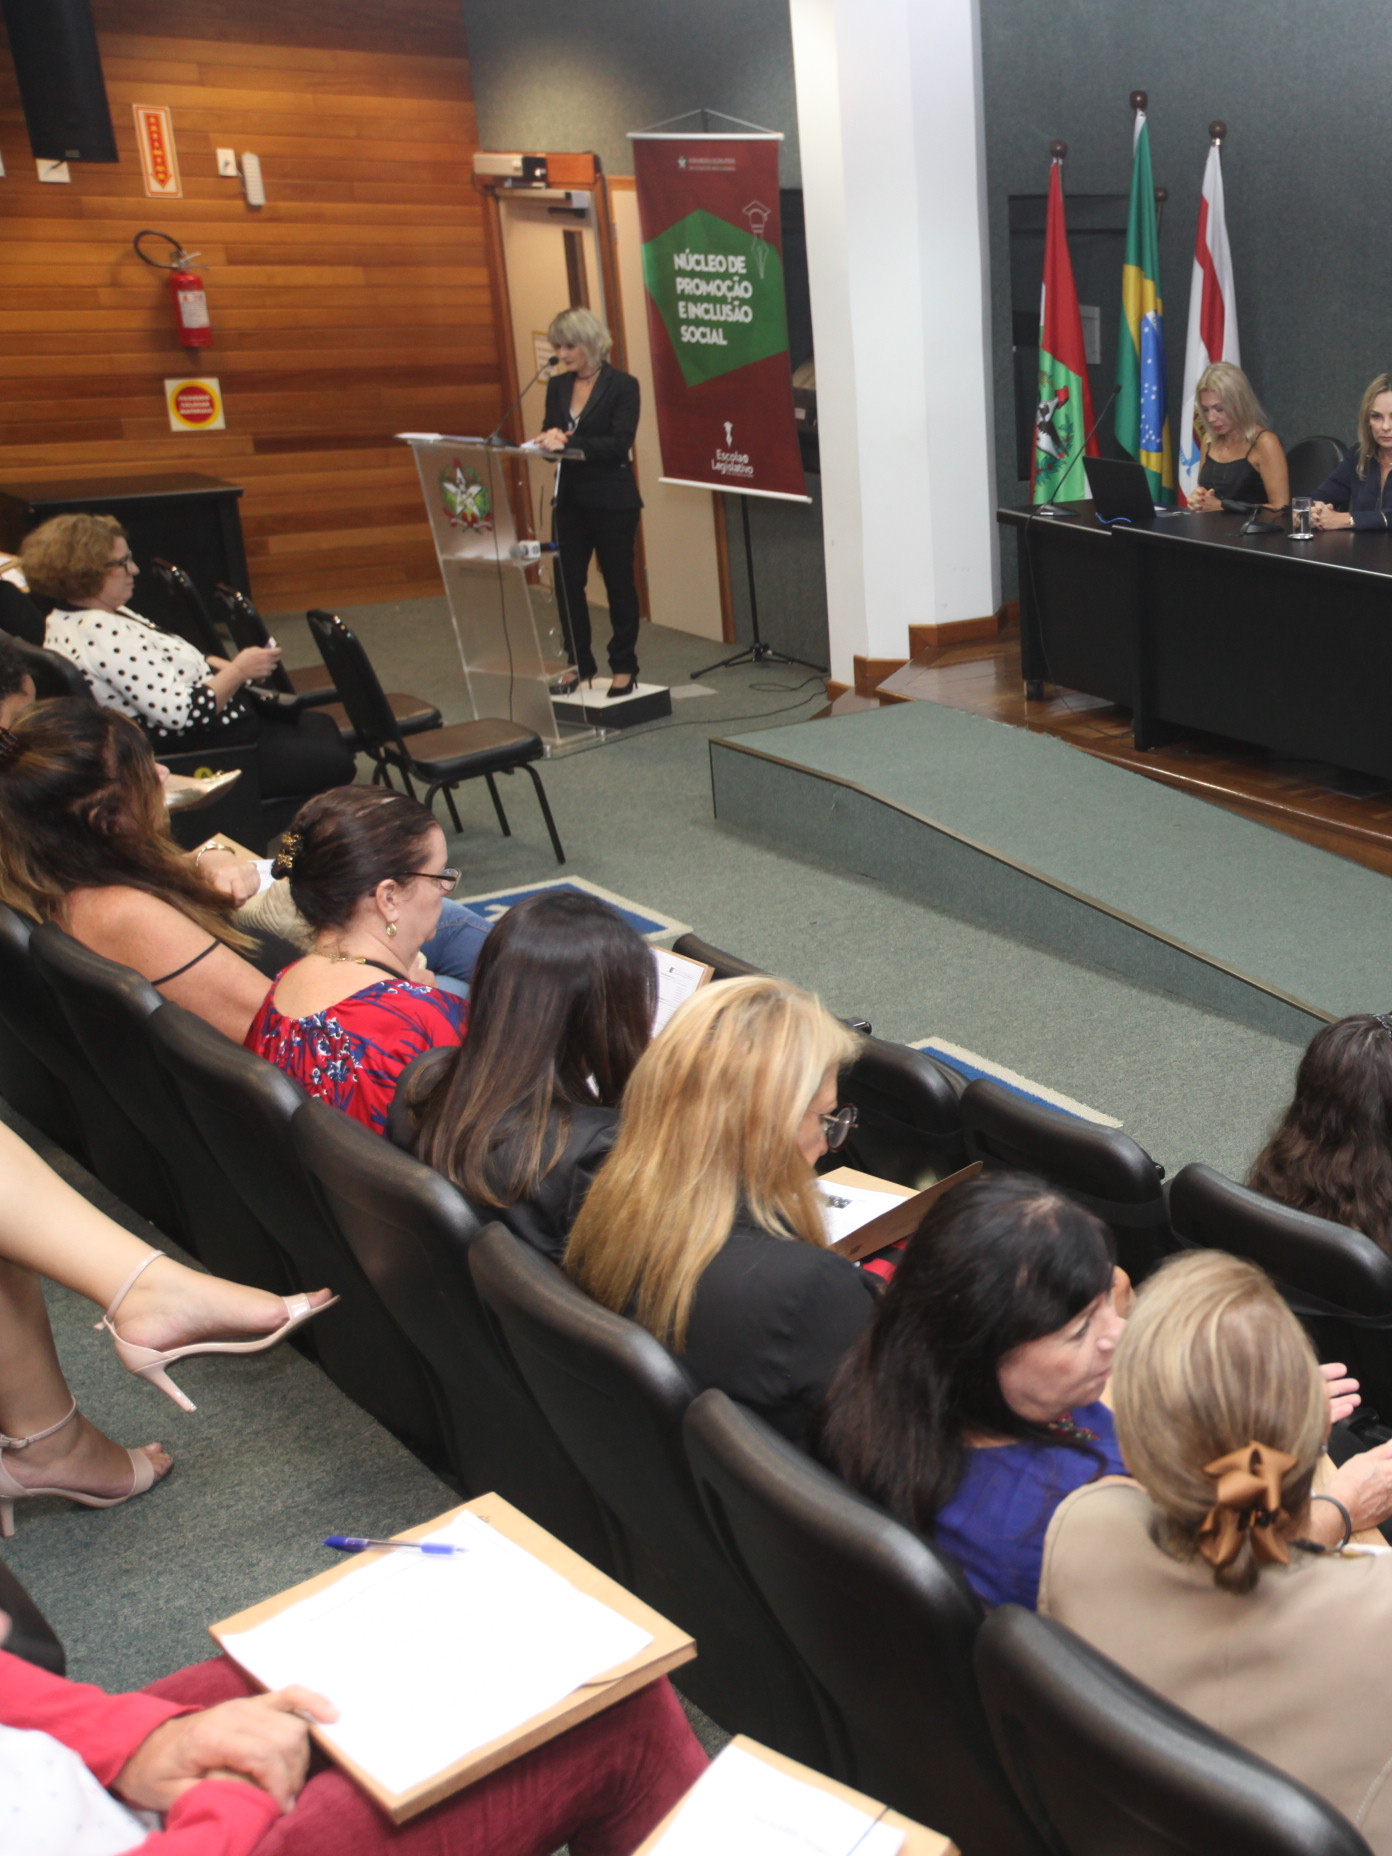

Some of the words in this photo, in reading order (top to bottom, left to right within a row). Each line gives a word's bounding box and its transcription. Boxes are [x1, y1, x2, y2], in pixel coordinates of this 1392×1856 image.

[673, 248, 727, 273] NÚCLEO
[727, 255, 747, 274] DE
[675, 276, 753, 302] PROMOÇÃO
[678, 301, 688, 319] E
[688, 300, 753, 323] INCLUSÃO
[680, 325, 728, 345] SOCIAL
